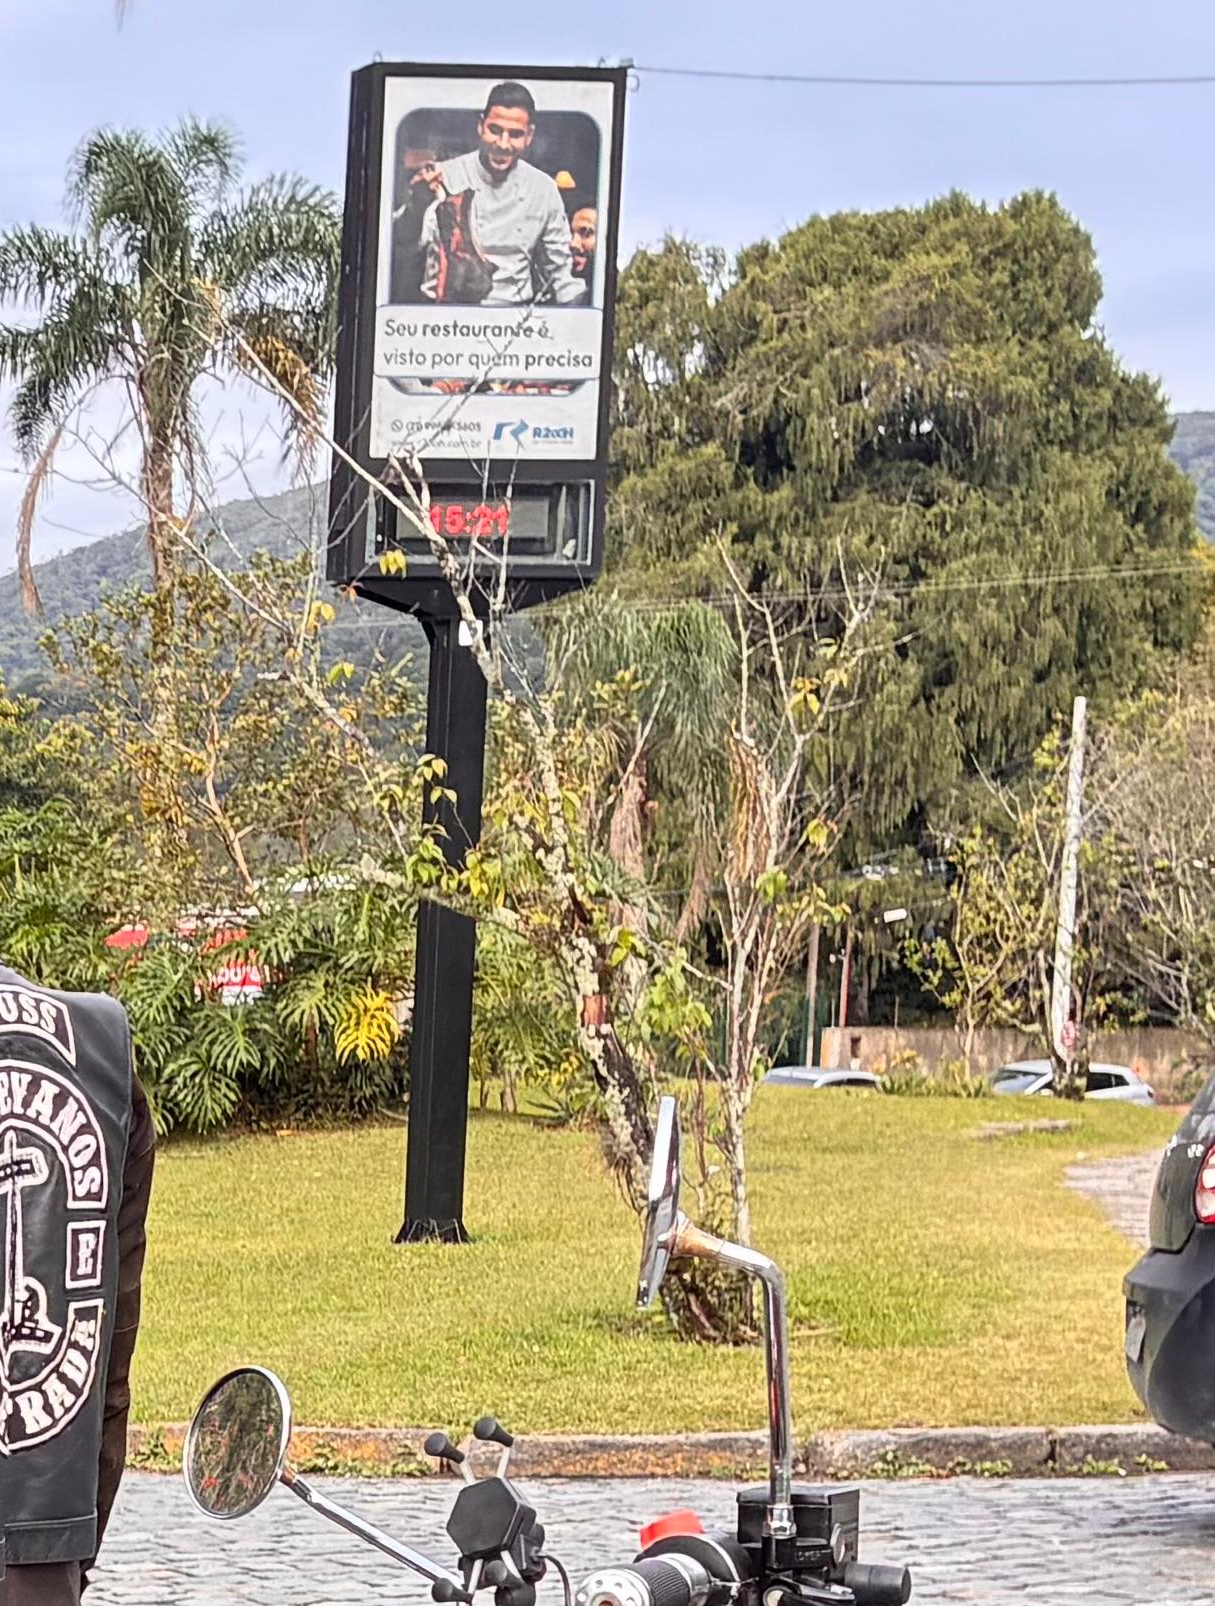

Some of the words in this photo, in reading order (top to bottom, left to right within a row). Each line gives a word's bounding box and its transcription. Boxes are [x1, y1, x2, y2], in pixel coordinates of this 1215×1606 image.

[384, 318, 418, 337] Seu
[422, 319, 535, 338] restaurante
[383, 347, 427, 366] visto
[431, 352, 465, 370] por
[468, 352, 520, 370] quem
[525, 348, 593, 371] precisa
[430, 504, 509, 536] 15:21
